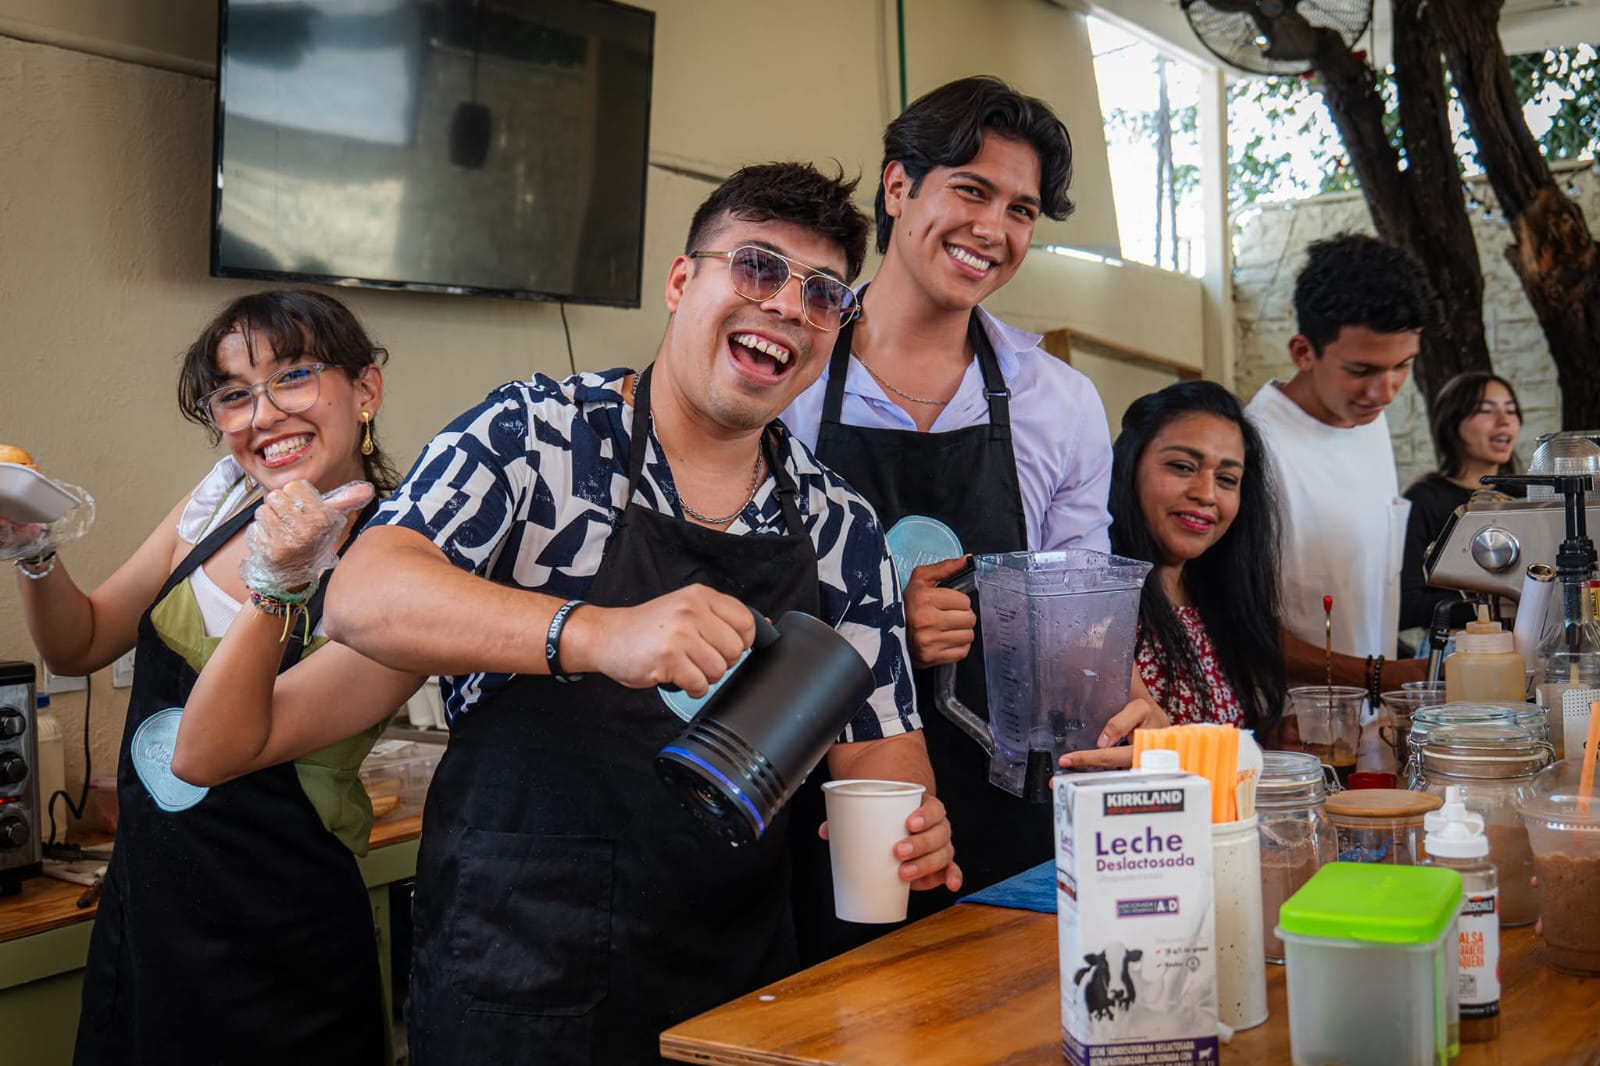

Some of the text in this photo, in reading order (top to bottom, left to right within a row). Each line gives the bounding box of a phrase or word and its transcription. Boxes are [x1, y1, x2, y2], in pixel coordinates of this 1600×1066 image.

[549, 604, 570, 639] SIMPLY
[1106, 790, 1183, 807] KIRKLAND
[1095, 826, 1183, 856] Leche
[1096, 853, 1195, 872] Deslactosada
[1459, 932, 1484, 945] ALSA
